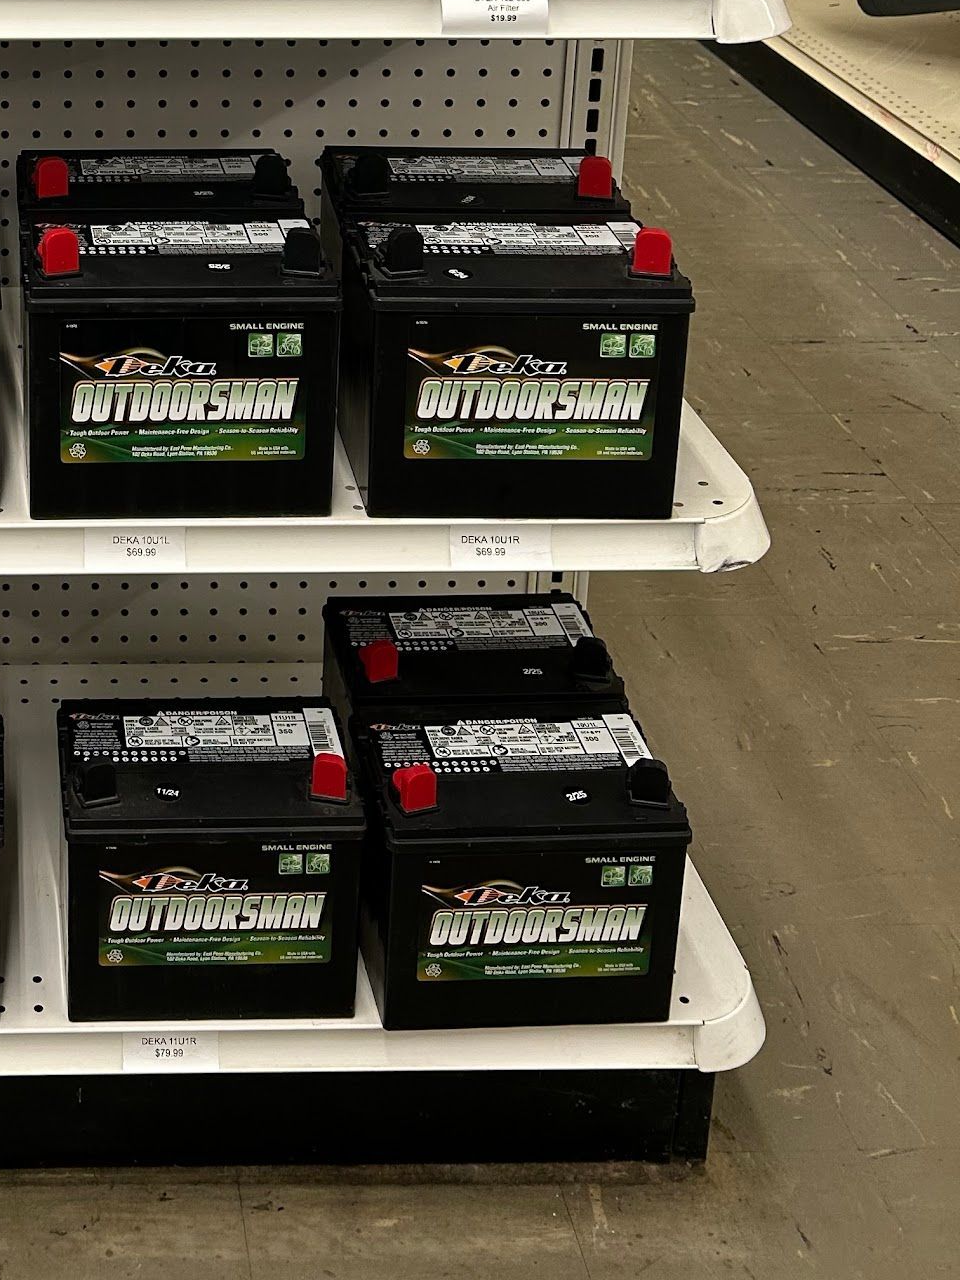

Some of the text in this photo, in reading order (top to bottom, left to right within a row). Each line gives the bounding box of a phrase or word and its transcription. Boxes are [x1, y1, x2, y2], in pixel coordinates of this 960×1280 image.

[488, 4, 520, 12] Air Filter
[490, 14, 517, 22] $19.99
[101, 356, 216, 377] Deka
[450, 353, 567, 376] Deka
[72, 379, 299, 422] OUTDOORSMAN
[417, 378, 650, 420] OUTDOORSMAN
[112, 536, 170, 545] DEKA 10U1L
[461, 535, 520, 544] DEKA 10U1R
[126, 547, 157, 558] $69.99
[476, 547, 506, 558] $69.99
[156, 788, 180, 798] 11/24
[566, 791, 587, 800] 2/25
[137, 873, 248, 891] Deka
[460, 886, 570, 905] Deka
[109, 892, 326, 931] OUTDOORSMAN
[430, 905, 647, 945] OUTDOORSMAN
[142, 1037, 197, 1045] DEKA 11U1R
[155, 1048, 184, 1058] $79.99
